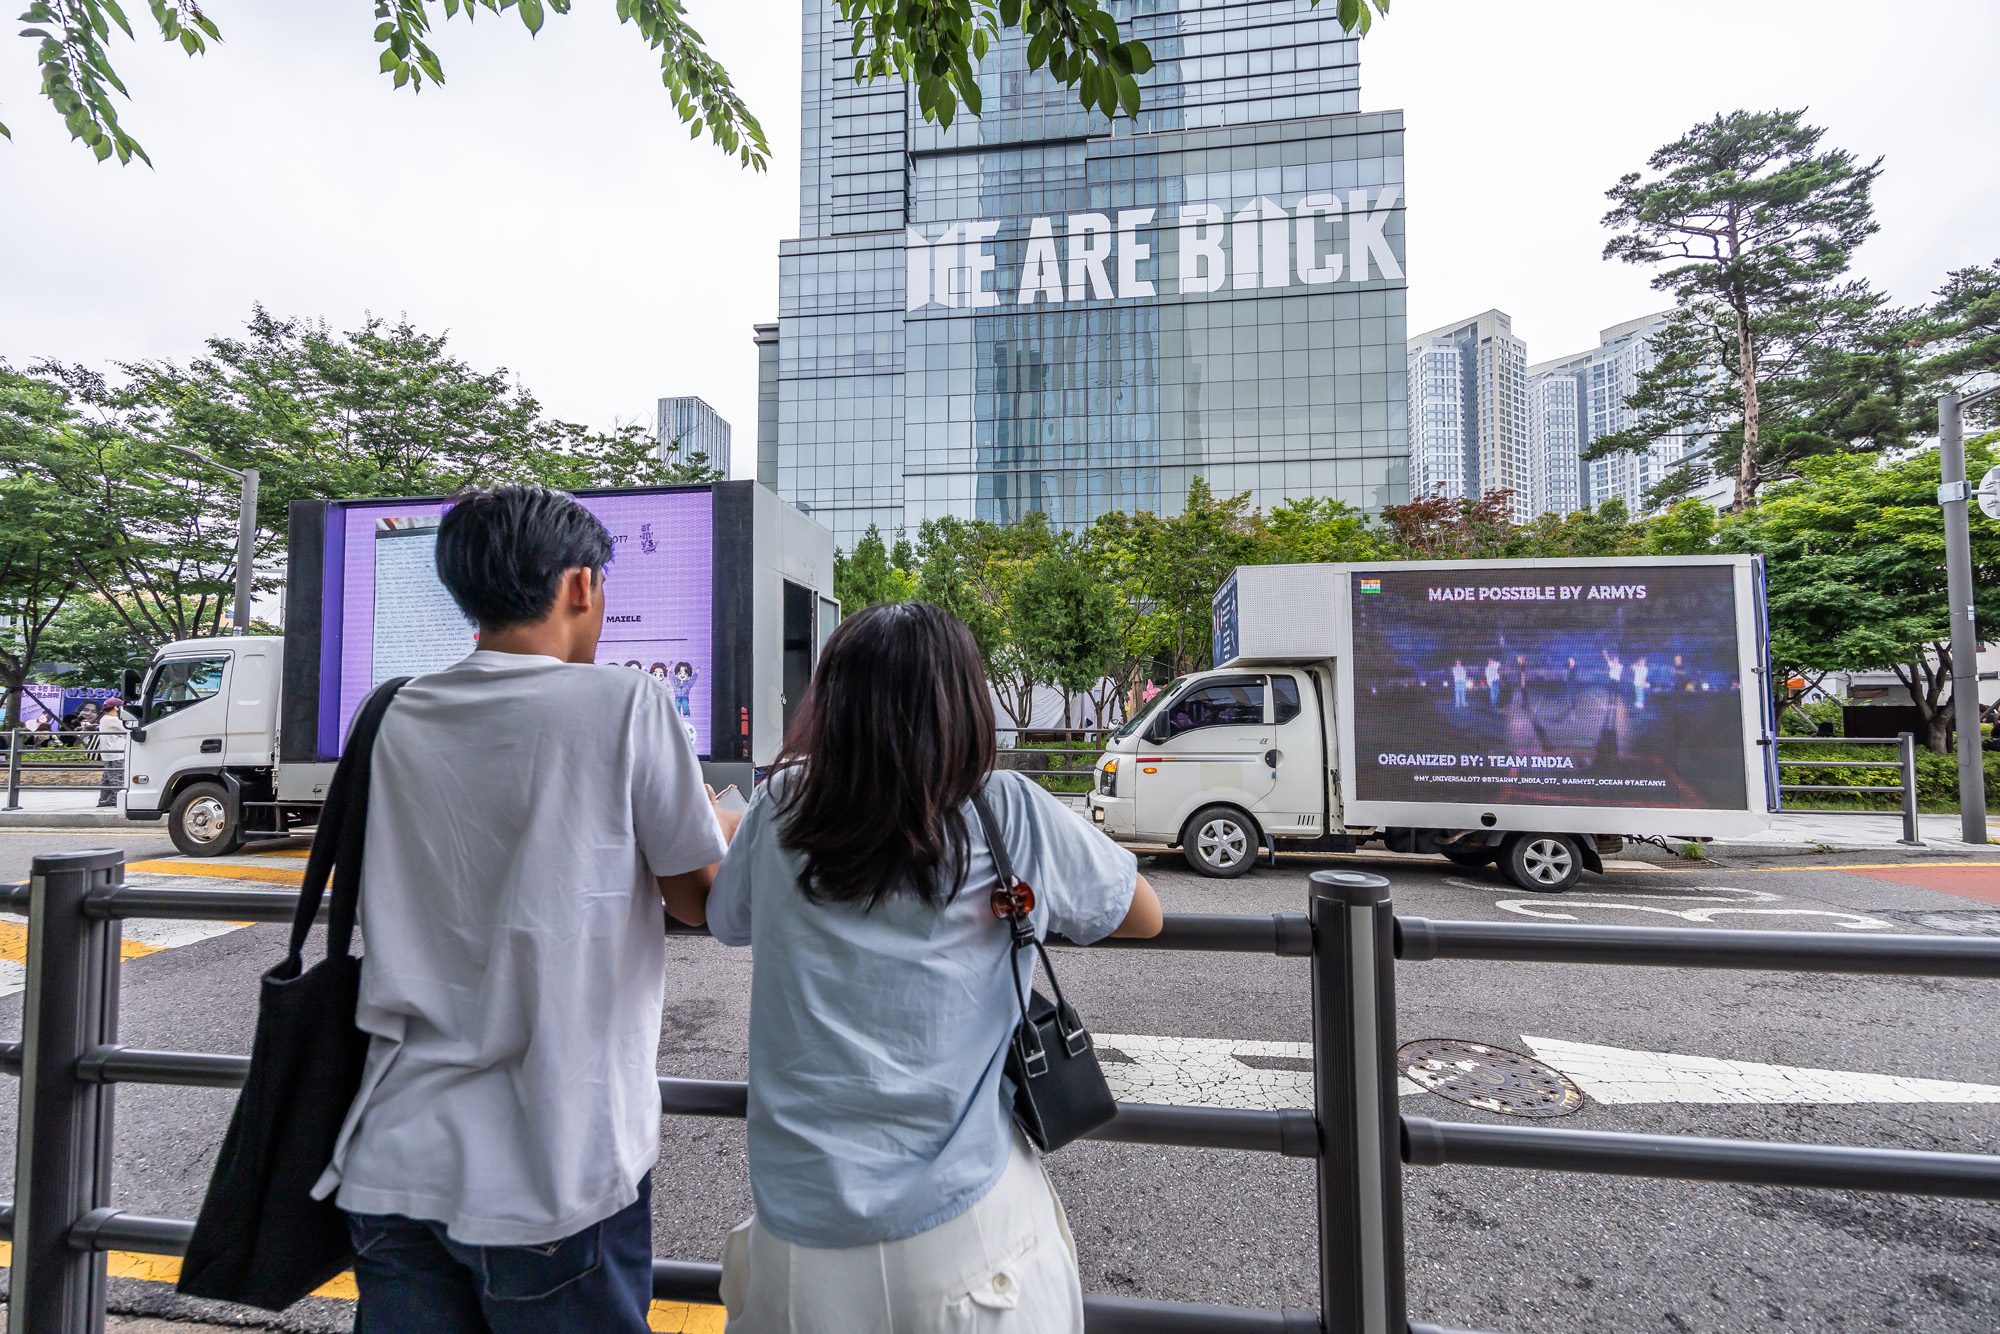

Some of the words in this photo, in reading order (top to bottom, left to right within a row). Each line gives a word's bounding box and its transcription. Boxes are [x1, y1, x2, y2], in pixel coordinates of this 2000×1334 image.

[1017, 208, 1158, 305] ARE
[1428, 587, 1475, 601] MADE
[1479, 586, 1556, 601] POSSIBLE
[1560, 586, 1582, 600] BY
[1587, 585, 1647, 600] ARMYS
[1378, 753, 1457, 767] ORGANIZED
[1460, 755, 1484, 767] BY:
[1488, 755, 1527, 768] TEAM
[1531, 756, 1574, 769] INDIA
